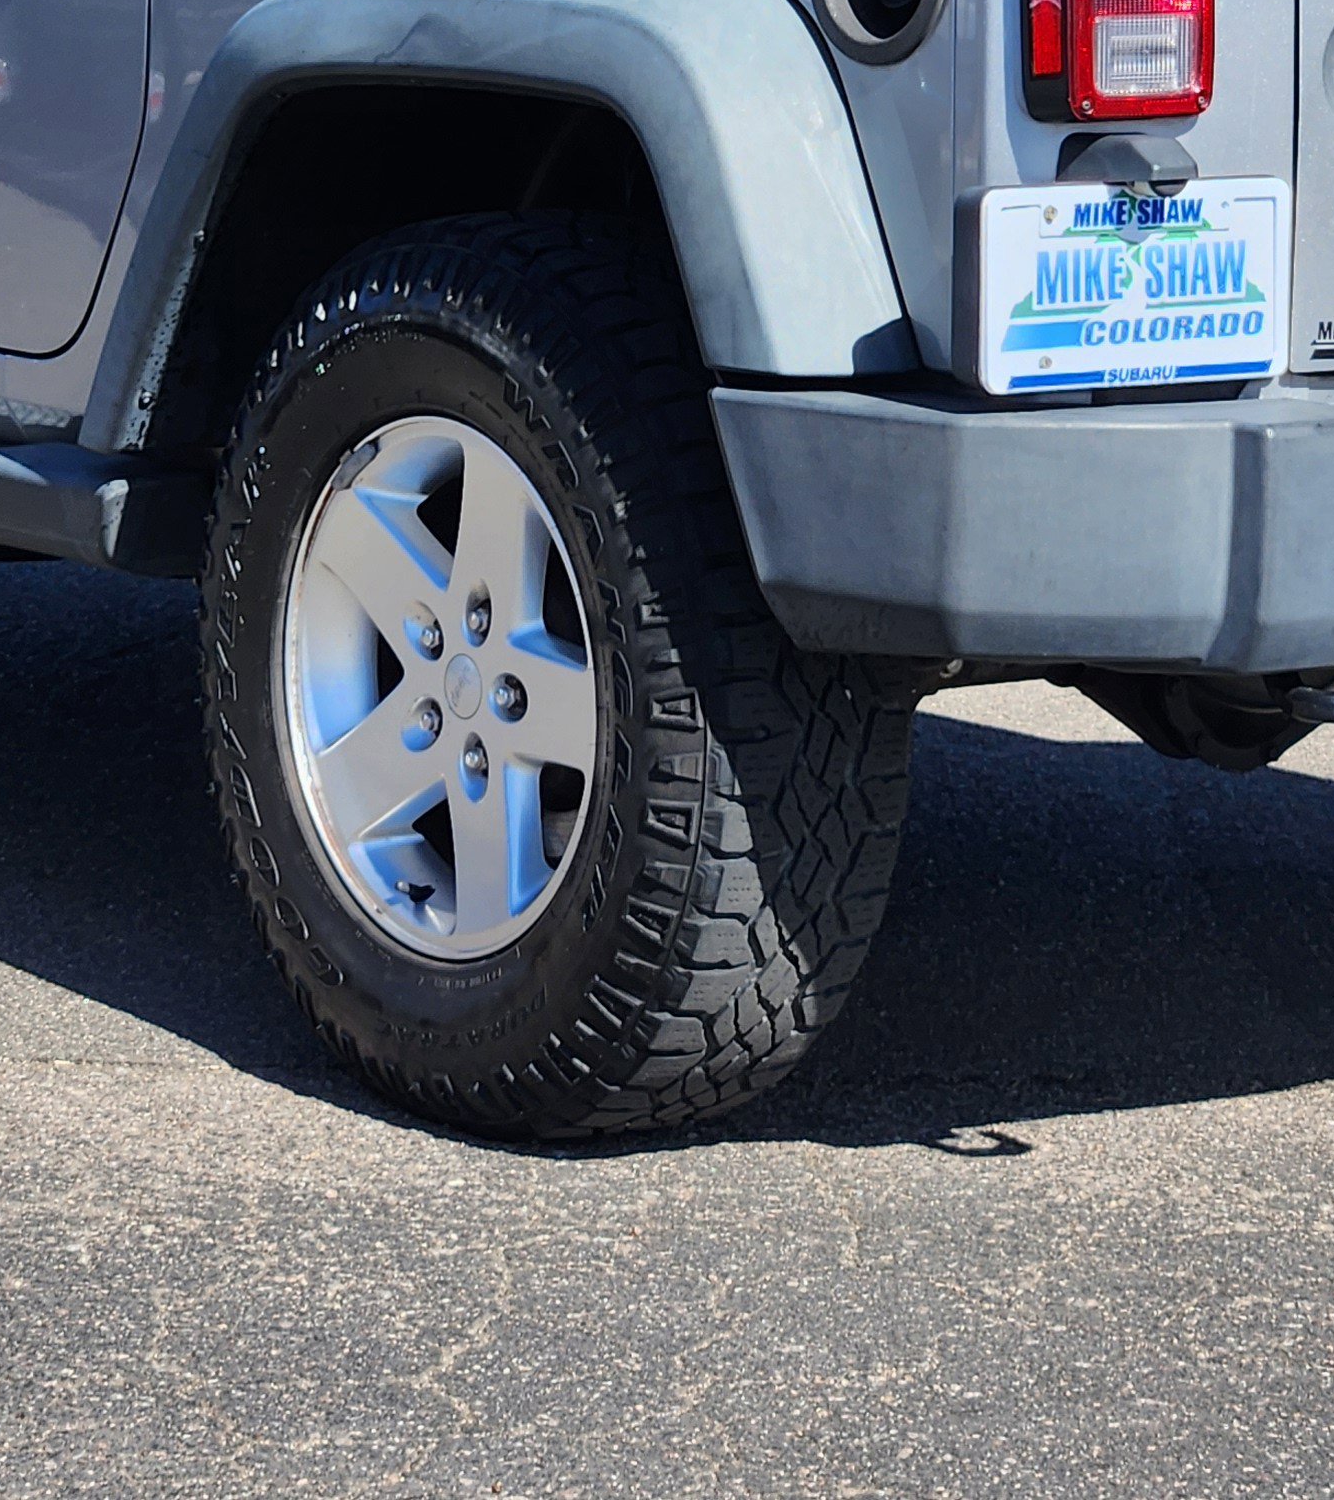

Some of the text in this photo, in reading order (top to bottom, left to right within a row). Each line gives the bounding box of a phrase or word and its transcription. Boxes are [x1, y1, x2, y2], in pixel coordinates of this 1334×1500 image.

[1073, 198, 1203, 228] MIKE SHAW
[1035, 240, 1247, 306] MIKE SHAW
[1083, 310, 1265, 346] COLORADO
[1107, 365, 1174, 383] SUBARU
